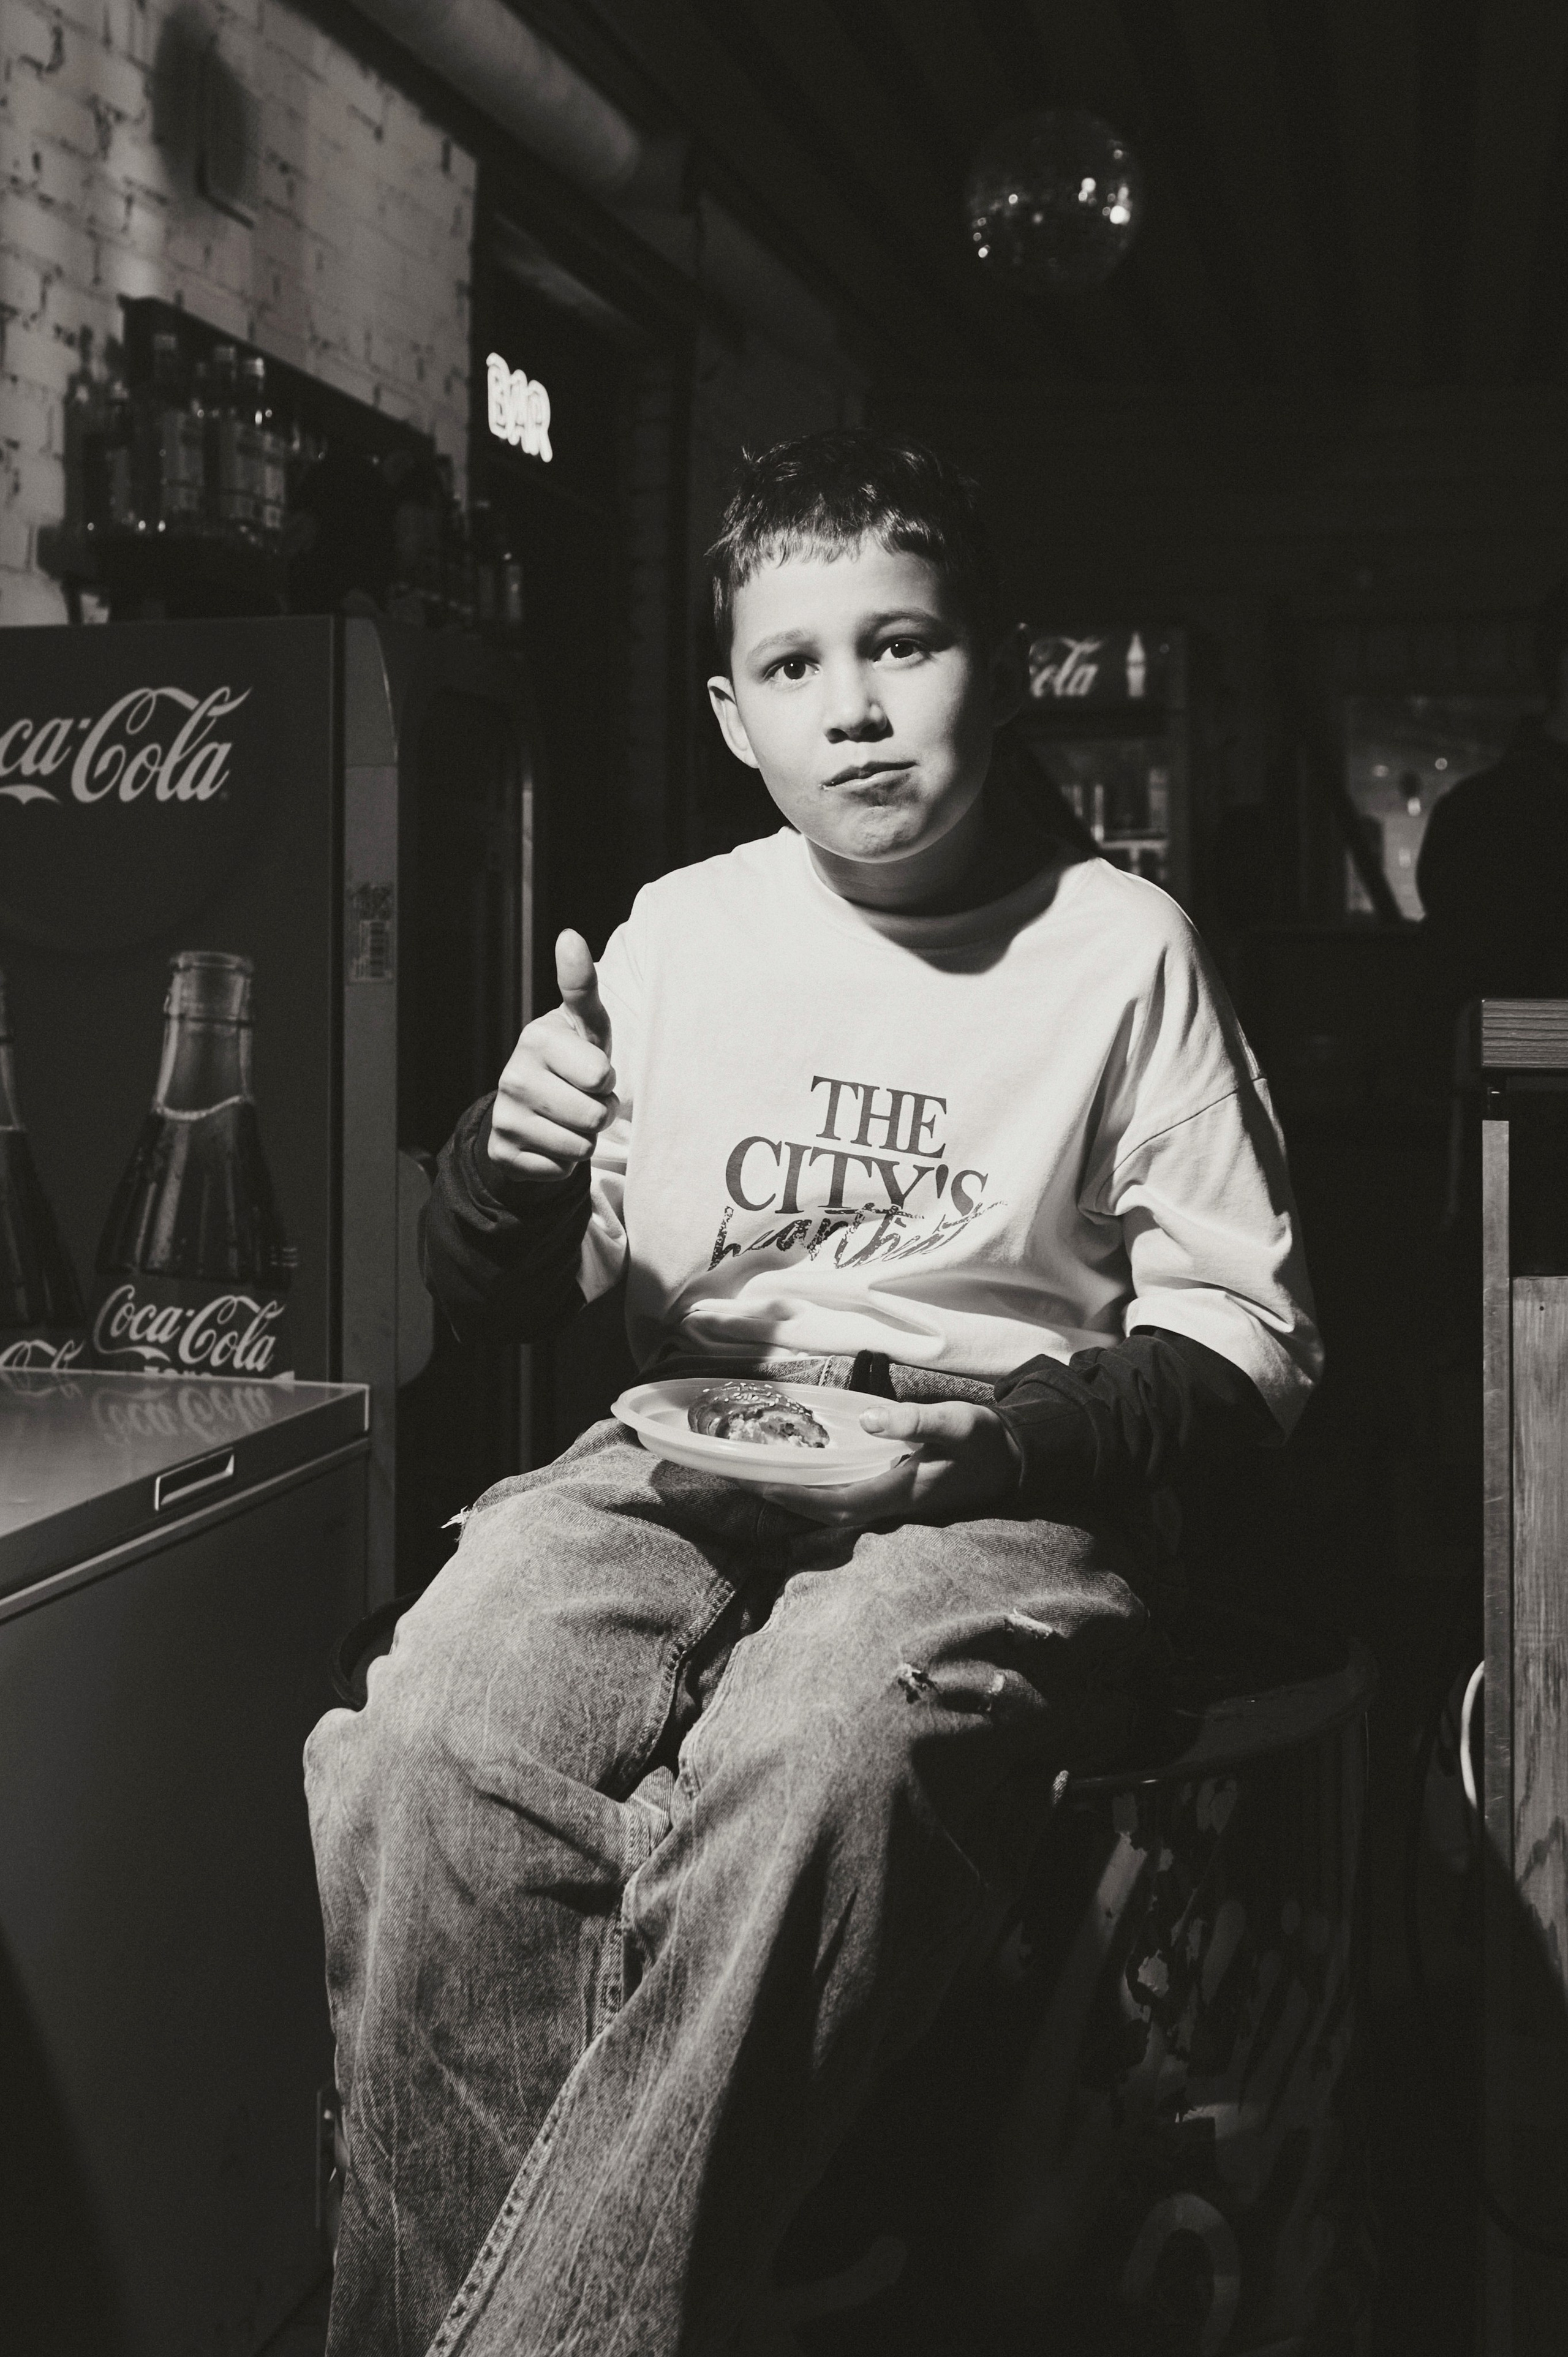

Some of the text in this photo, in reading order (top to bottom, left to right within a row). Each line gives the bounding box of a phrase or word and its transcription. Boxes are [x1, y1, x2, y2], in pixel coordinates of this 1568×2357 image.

[486, 352, 553, 463] BAR
[0, 686, 252, 805] ca-Cola
[810, 1075, 948, 1159] THE
[725, 1136, 989, 1217] CITY'S
[93, 1284, 285, 1372] Coca-Cola
